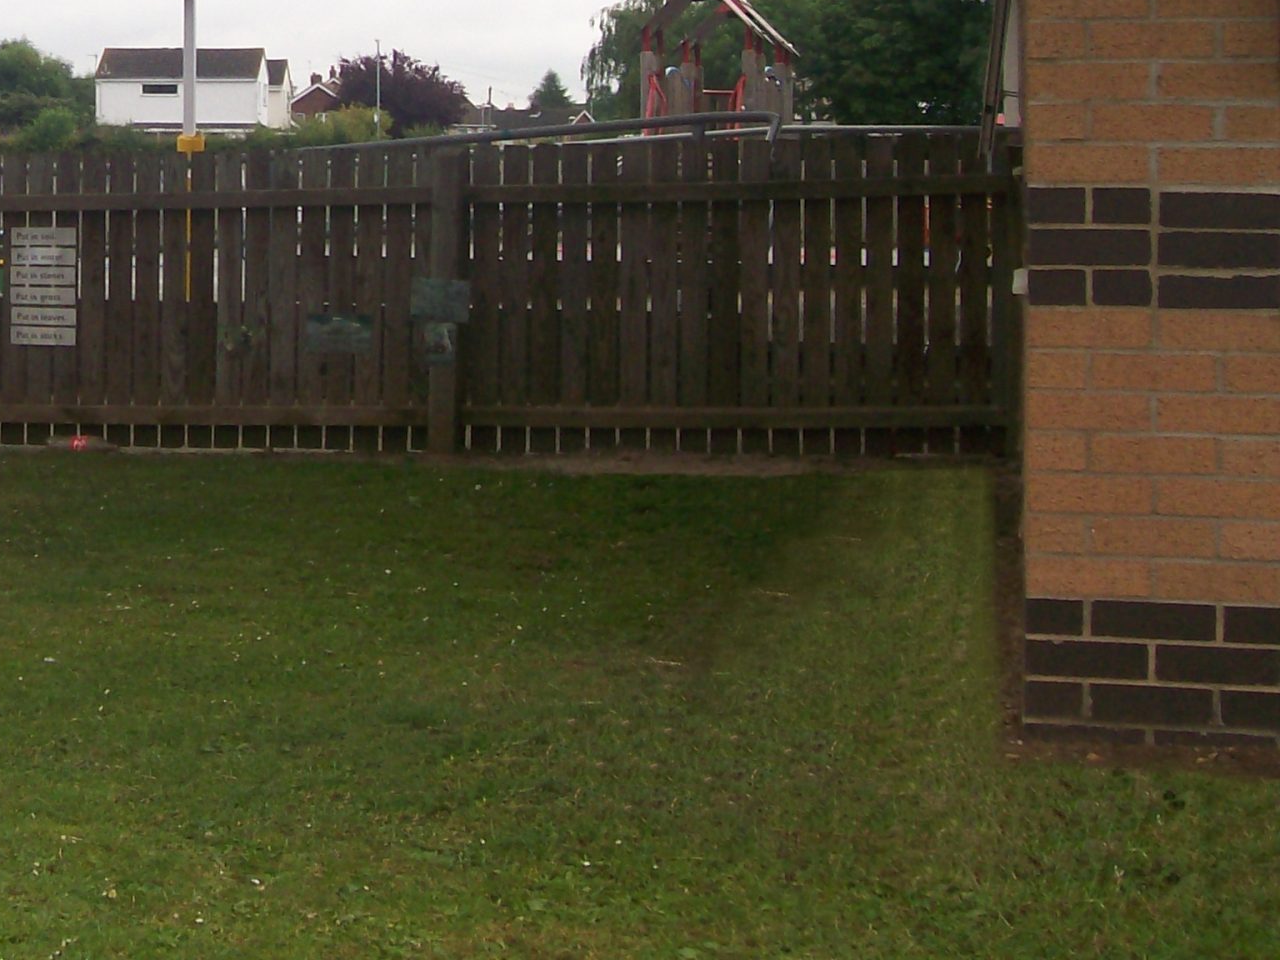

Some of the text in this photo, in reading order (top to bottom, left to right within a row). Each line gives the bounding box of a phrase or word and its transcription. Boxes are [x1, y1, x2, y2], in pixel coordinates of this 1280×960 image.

[16, 232, 28, 240] Put
[16, 253, 28, 261] Put
[16, 271, 28, 279] Put
[16, 292, 28, 300] Put
[17, 312, 29, 321] Put
[16, 331, 28, 339] Put
